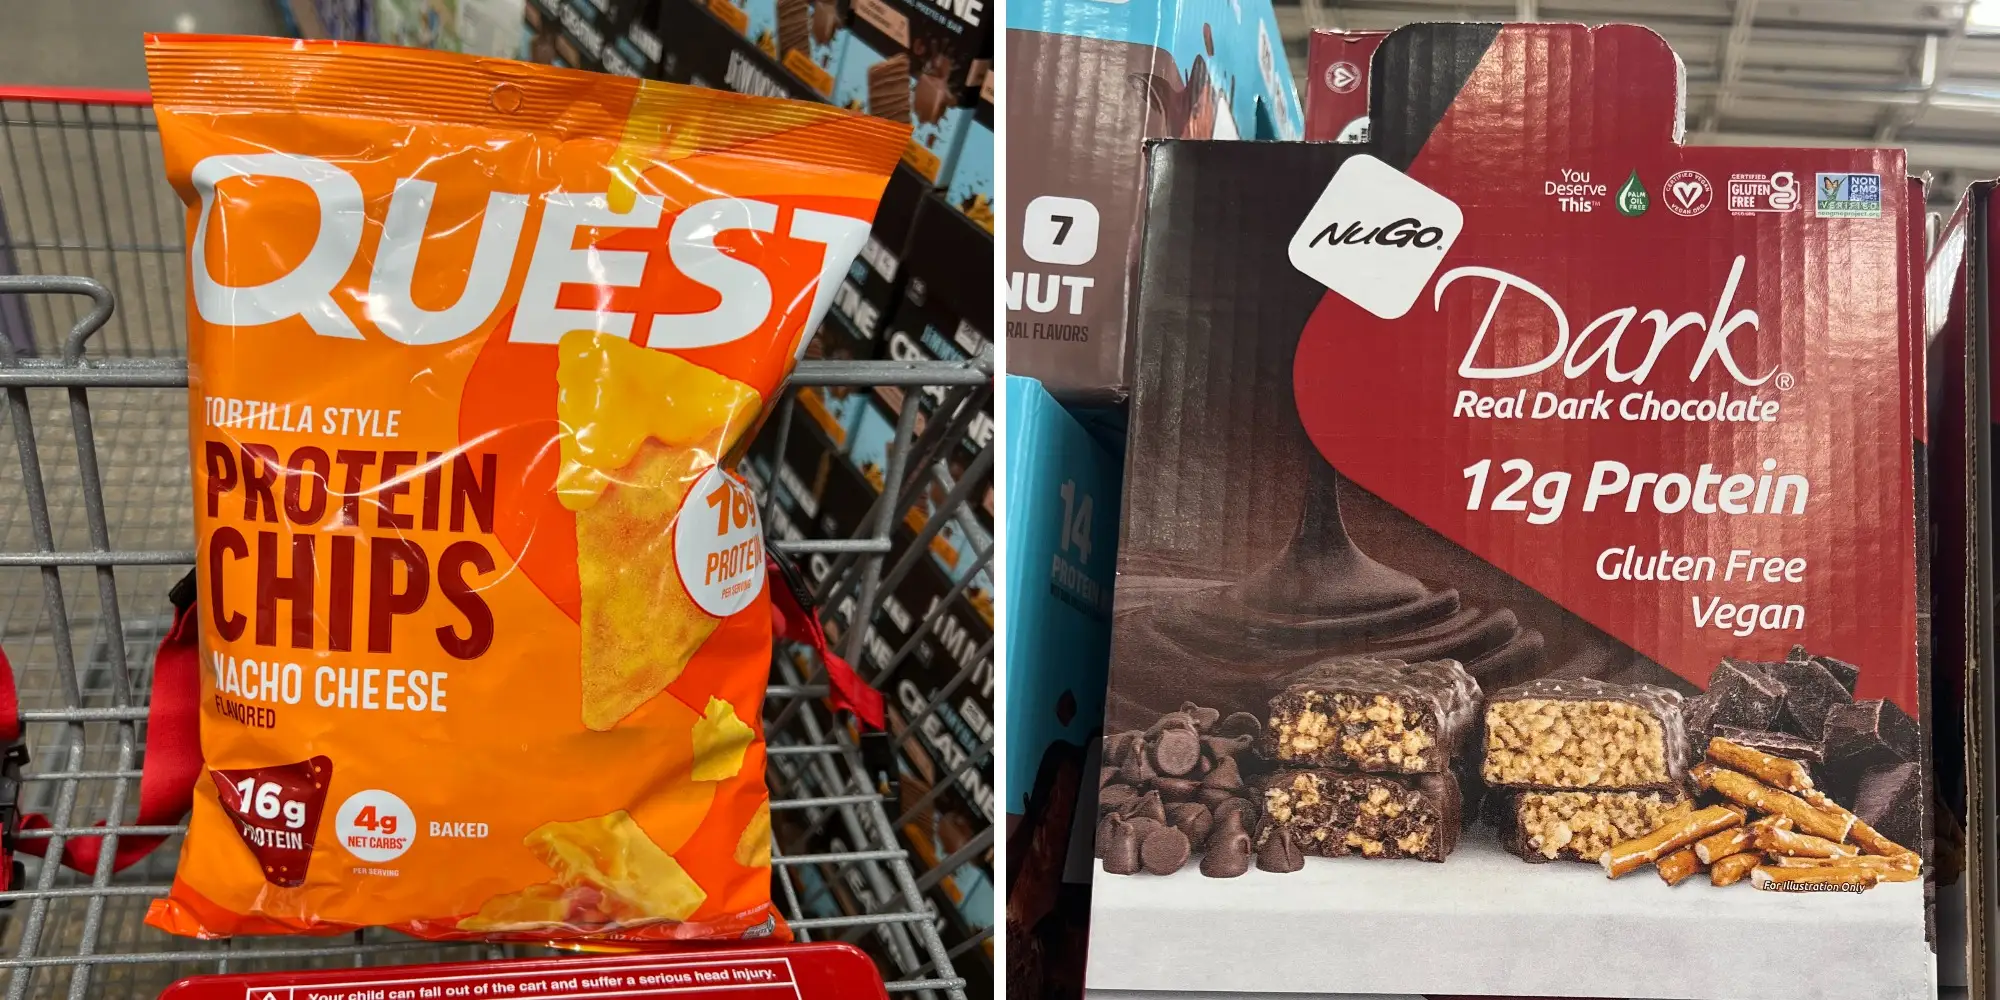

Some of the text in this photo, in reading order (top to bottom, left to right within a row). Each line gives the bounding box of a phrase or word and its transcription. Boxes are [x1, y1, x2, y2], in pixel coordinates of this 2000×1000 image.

[1545, 181, 1607, 196] Deserve
[1561, 168, 1590, 183] You
[1666, 172, 1711, 193] CERTIFIED VEGAN
[1731, 184, 1771, 196] GLUTEN
[1850, 185, 1878, 193] GMO
[1851, 176, 1877, 185] NON
[1731, 197, 1755, 208] FREE
[1821, 201, 1878, 210] VERIFIED
[1050, 214, 1074, 246] 7
[1309, 217, 1444, 249] NuGo
[191, 153, 873, 361] QUEST
[1033, 322, 1089, 342] FLAVORS
[205, 396, 401, 438] TORTILLA STYLE
[1453, 389, 1780, 422] Real Dark Chocolate
[205, 440, 498, 534] PROTEIN
[1463, 457, 1810, 525] 12g Protein
[1060, 478, 1094, 565] 14
[1596, 545, 1807, 583] Gluten Free
[209, 526, 497, 661] CHIPS
[1691, 595, 1806, 637] Vegan
[213, 650, 448, 713] NACHO CHEESE
[215, 694, 276, 729] FLAVORED
[236, 777, 306, 828] 16g
[353, 805, 398, 835] 4g
[429, 821, 489, 838] BAKED
[347, 836, 368, 849] NET
[353, 867, 399, 877] PER SERVING
[1763, 880, 1866, 894] For Illustration Only
[348, 989, 385, 1000] child
[388, 989, 416, 1000] can
[419, 985, 442, 998] fall
[445, 984, 470, 996] out
[473, 983, 489, 995] of
[491, 981, 516, 993] the
[519, 979, 548, 992] cart
[550, 977, 578, 990] and
[581, 975, 625, 988] suffer
[626, 976, 636, 986] a
[638, 971, 692, 985] serious
[694, 969, 729, 982] head
[731, 967, 777, 982] injury.
